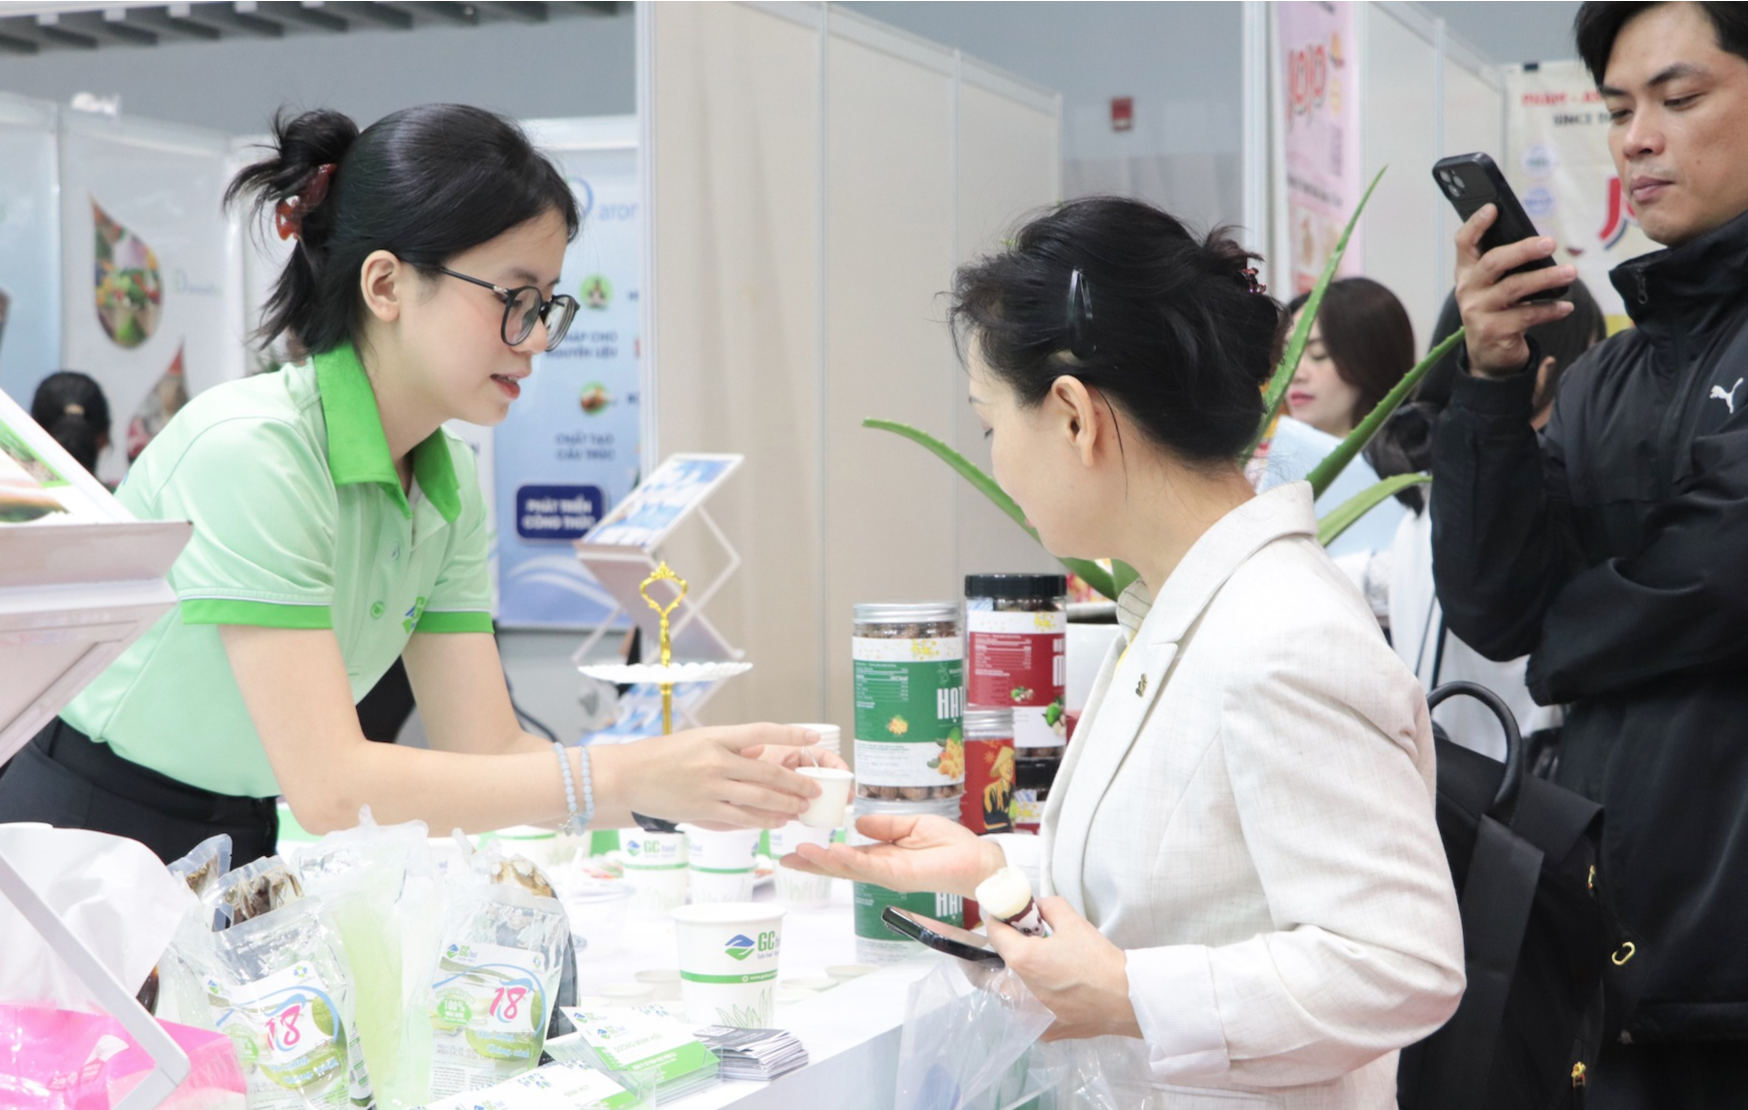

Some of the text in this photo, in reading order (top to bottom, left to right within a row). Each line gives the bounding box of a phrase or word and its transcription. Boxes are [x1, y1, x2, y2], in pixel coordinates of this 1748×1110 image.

[757, 930, 775, 952] GC
[490, 986, 527, 1020] 18
[264, 1003, 302, 1051] 18
